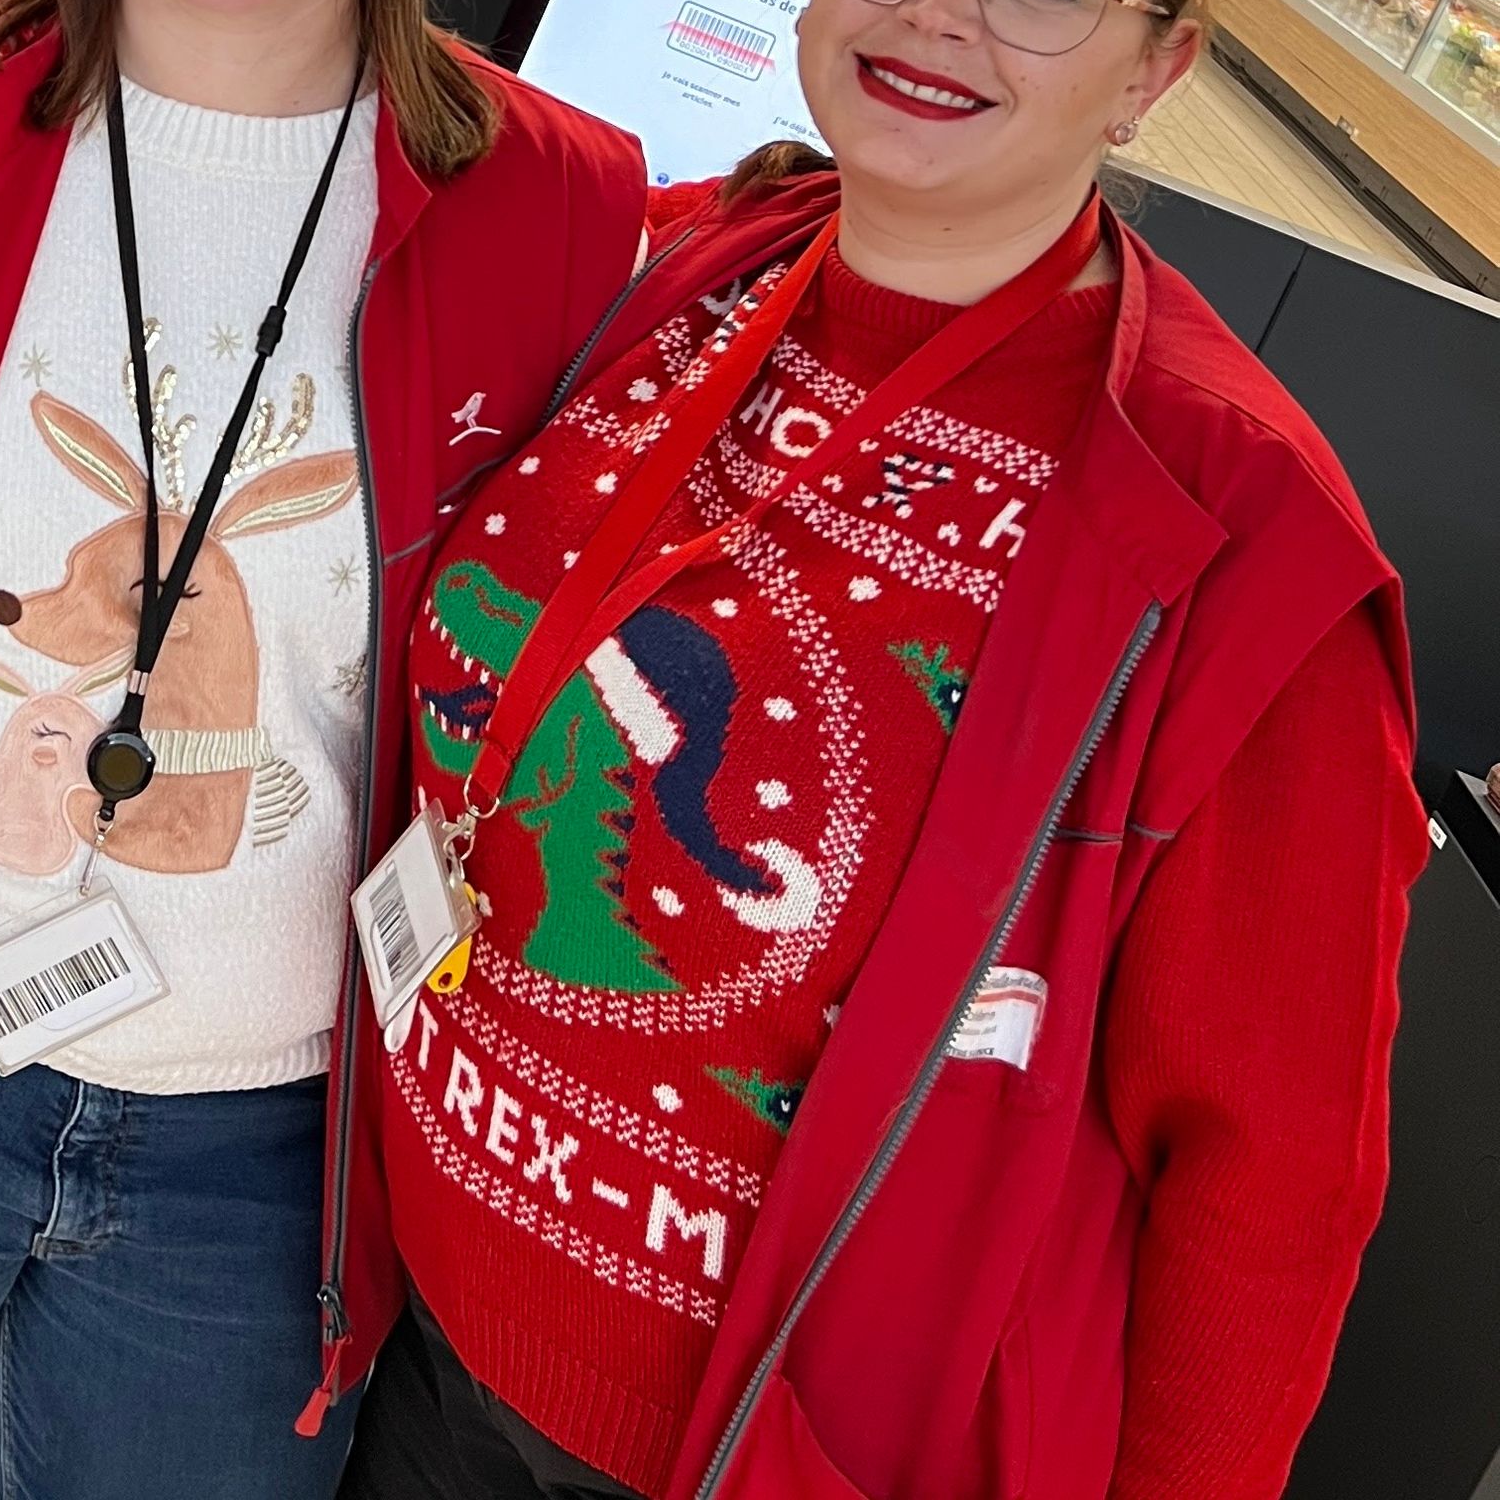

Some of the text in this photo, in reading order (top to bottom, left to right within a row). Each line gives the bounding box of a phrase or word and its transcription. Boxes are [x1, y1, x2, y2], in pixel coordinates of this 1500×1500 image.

[738, 381, 833, 458] HO
[417, 997, 728, 1281] T REX-M
